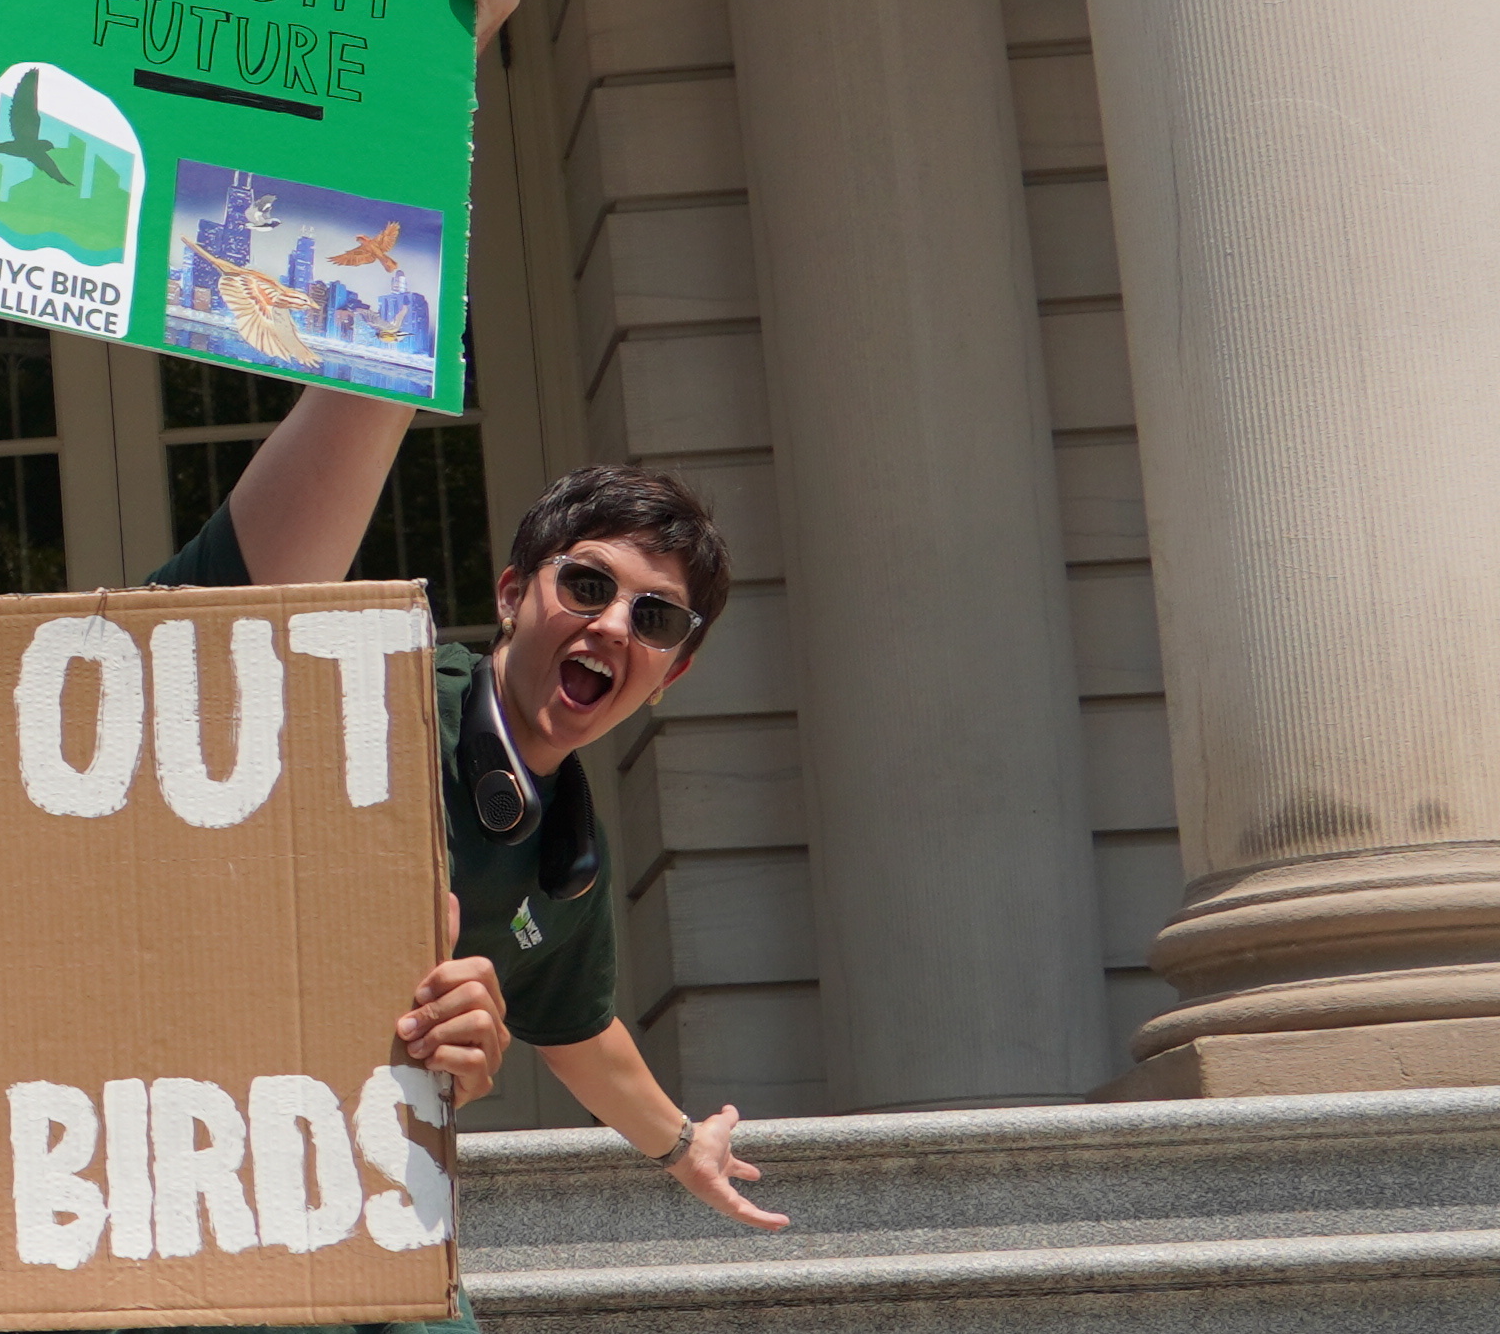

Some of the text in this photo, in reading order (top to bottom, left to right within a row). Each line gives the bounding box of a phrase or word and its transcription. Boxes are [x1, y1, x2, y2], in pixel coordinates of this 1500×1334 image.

[51, 272, 122, 307] BIRD
[14, 609, 435, 830] OUT
[8, 1064, 453, 1269] BIRDS
